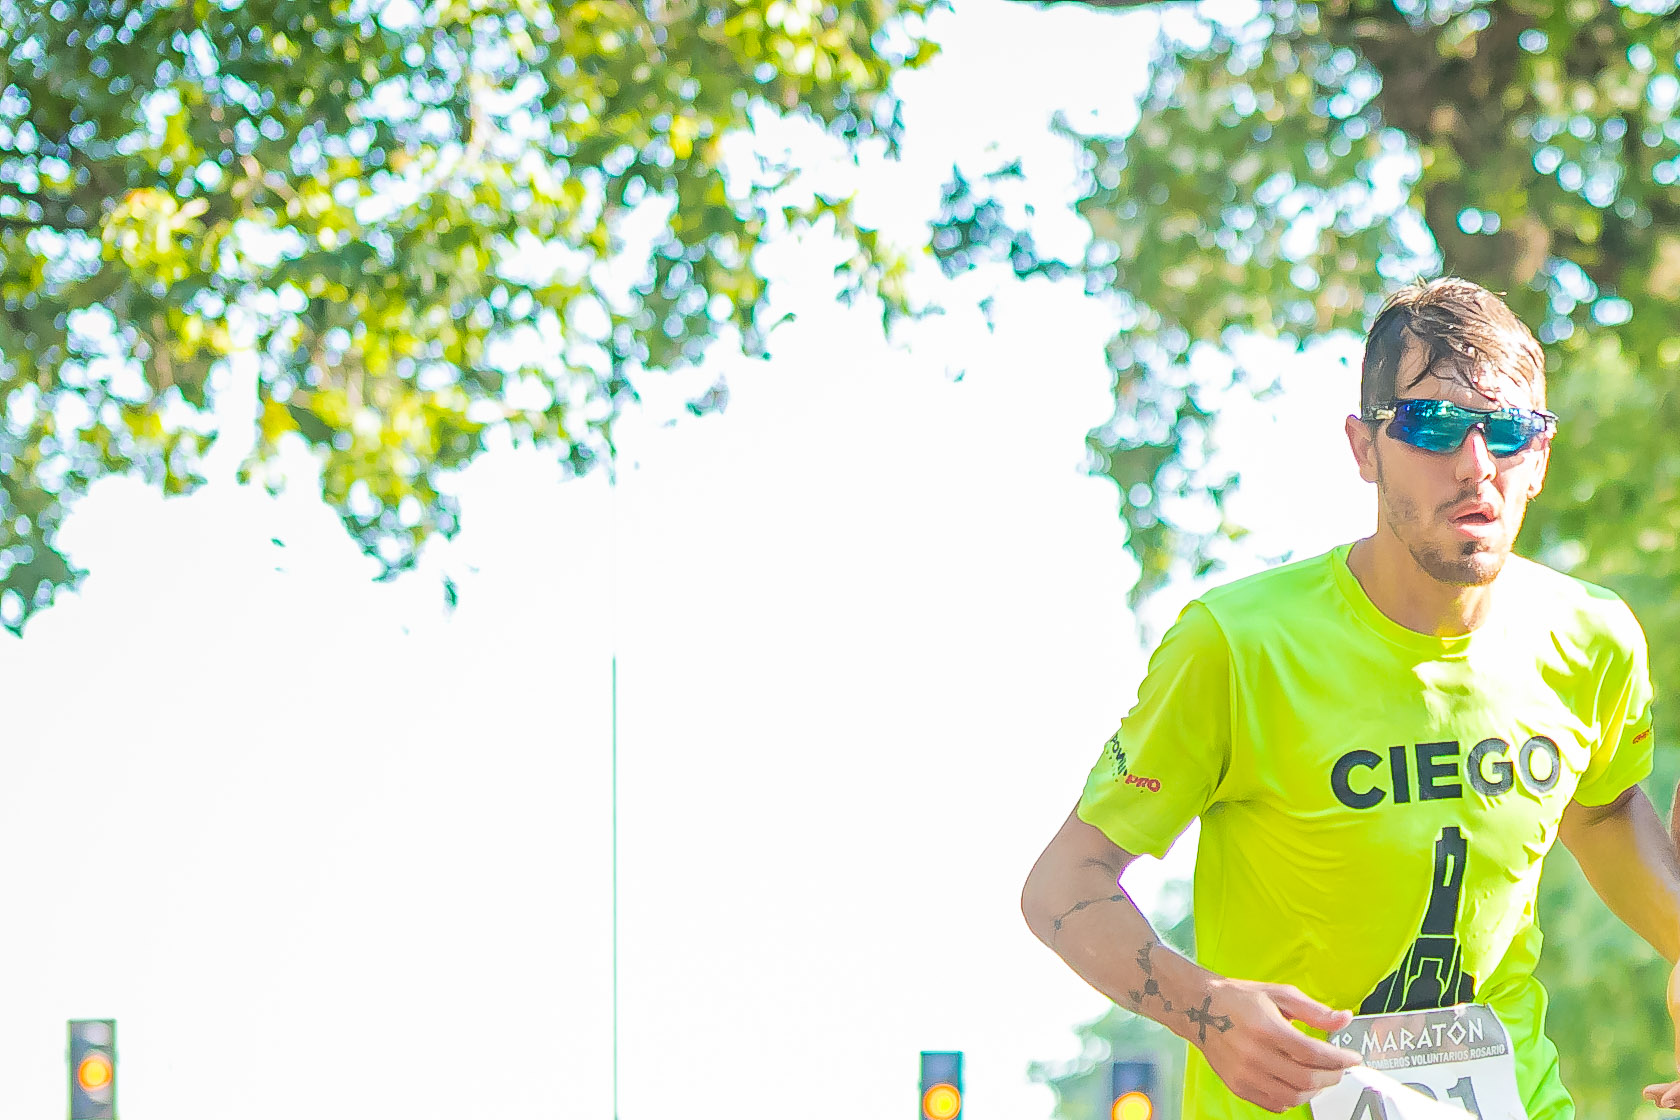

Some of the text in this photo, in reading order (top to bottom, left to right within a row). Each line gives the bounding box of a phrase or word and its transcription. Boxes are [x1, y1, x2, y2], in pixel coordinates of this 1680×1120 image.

[1331, 735, 1560, 809] CIEGO
[1361, 1017, 1484, 1055] MARATÓN
[1411, 1049, 1469, 1067] VOLUNTARIOS
[1470, 1044, 1506, 1060] ROSARIO
